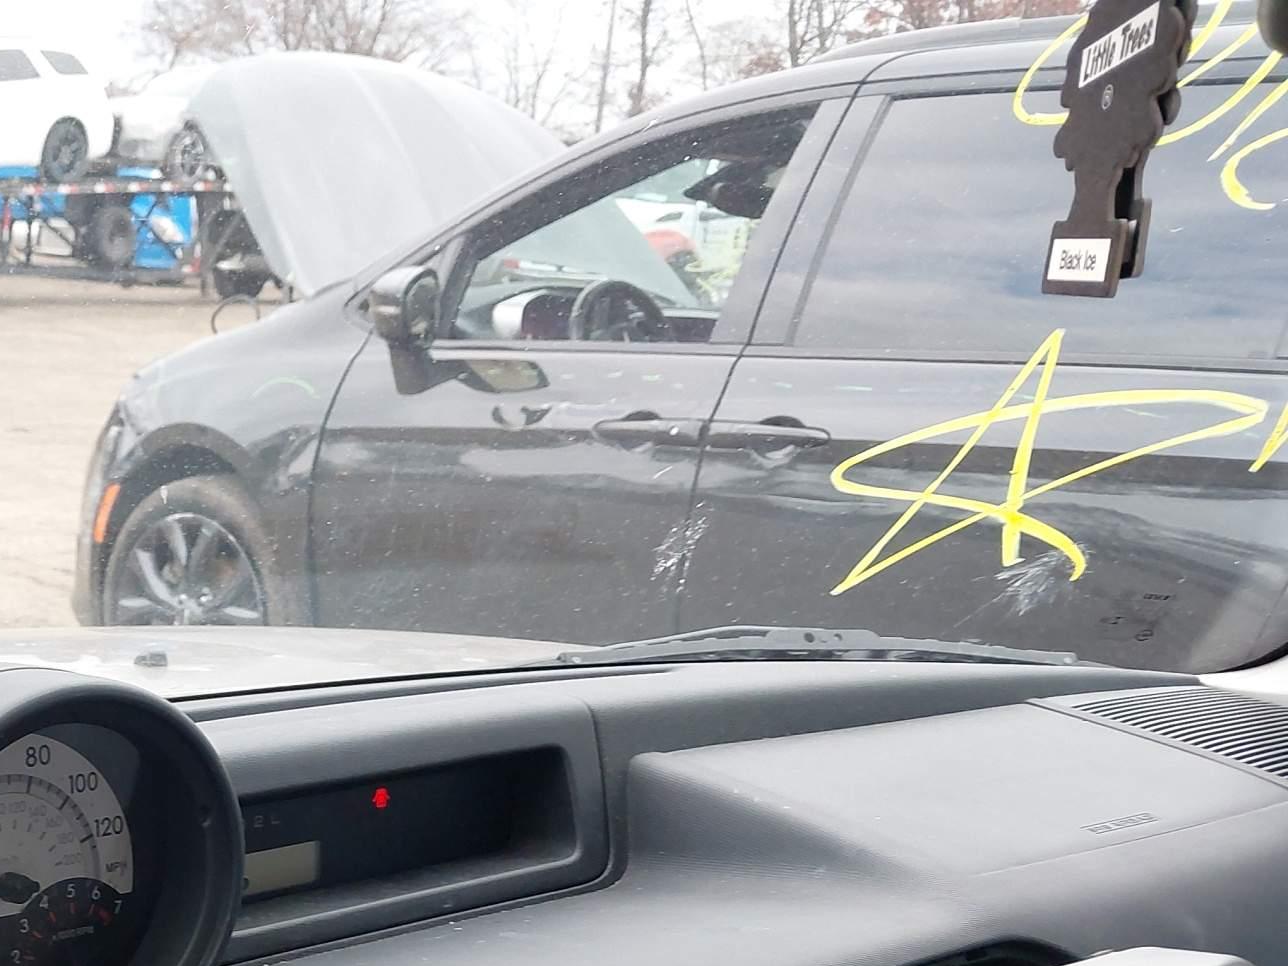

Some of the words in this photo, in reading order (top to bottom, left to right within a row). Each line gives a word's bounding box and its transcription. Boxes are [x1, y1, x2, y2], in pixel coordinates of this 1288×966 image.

[1083, 34, 1116, 83] Little
[1120, 18, 1154, 60] Trees
[1059, 249, 1083, 270] Black
[1083, 249, 1097, 271] Ice
[25, 745, 51, 767] 80
[69, 771, 98, 794] 100
[94, 815, 124, 838] 120
[66, 883, 76, 898] 5
[91, 885, 101, 900] 6
[39, 895, 49, 909] 4
[113, 899, 123, 915] 7
[19, 918, 30, 933] 3
[11, 950, 21, 964] 2
